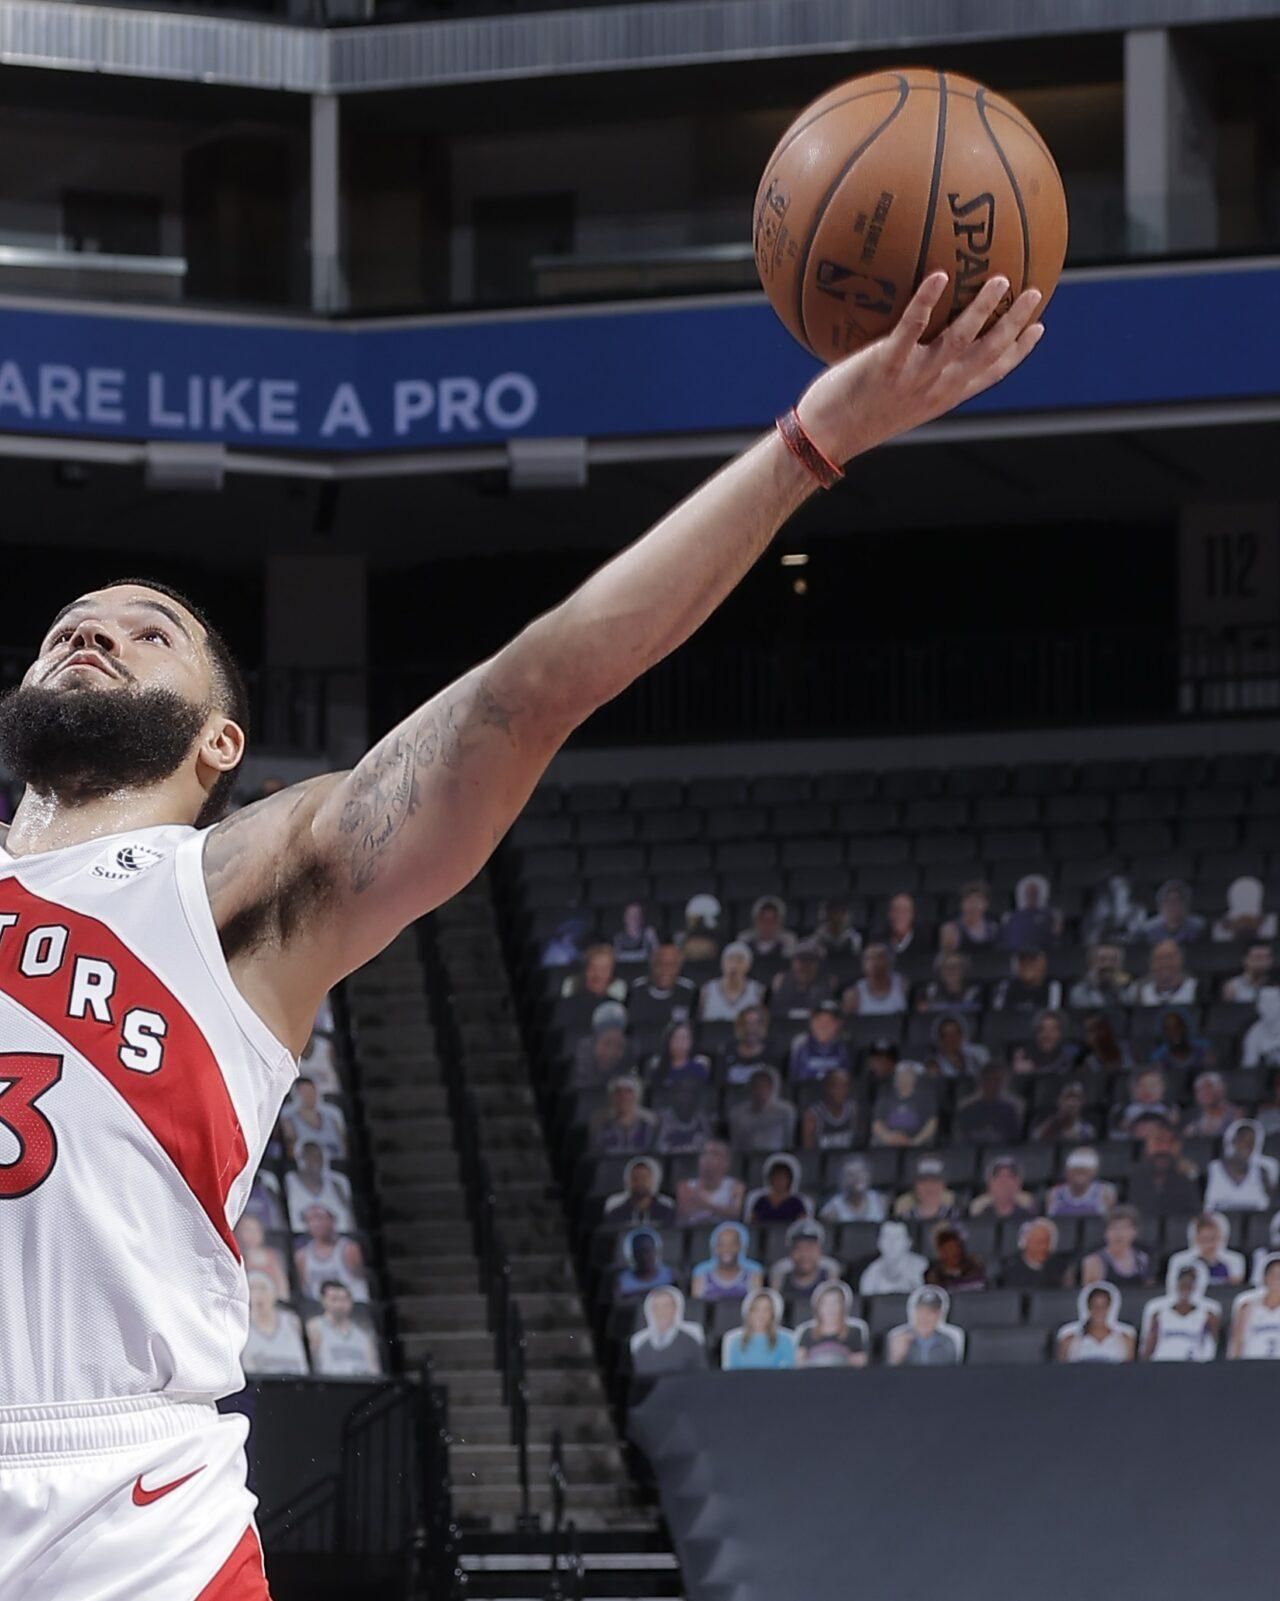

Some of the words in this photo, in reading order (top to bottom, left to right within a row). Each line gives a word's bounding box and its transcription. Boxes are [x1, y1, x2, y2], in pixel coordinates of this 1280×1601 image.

[149, 373, 300, 434] LIKE
[321, 385, 372, 437] A
[394, 372, 538, 435] PRO
[1203, 531, 1258, 598] 112
[92, 866, 130, 880] Sun
